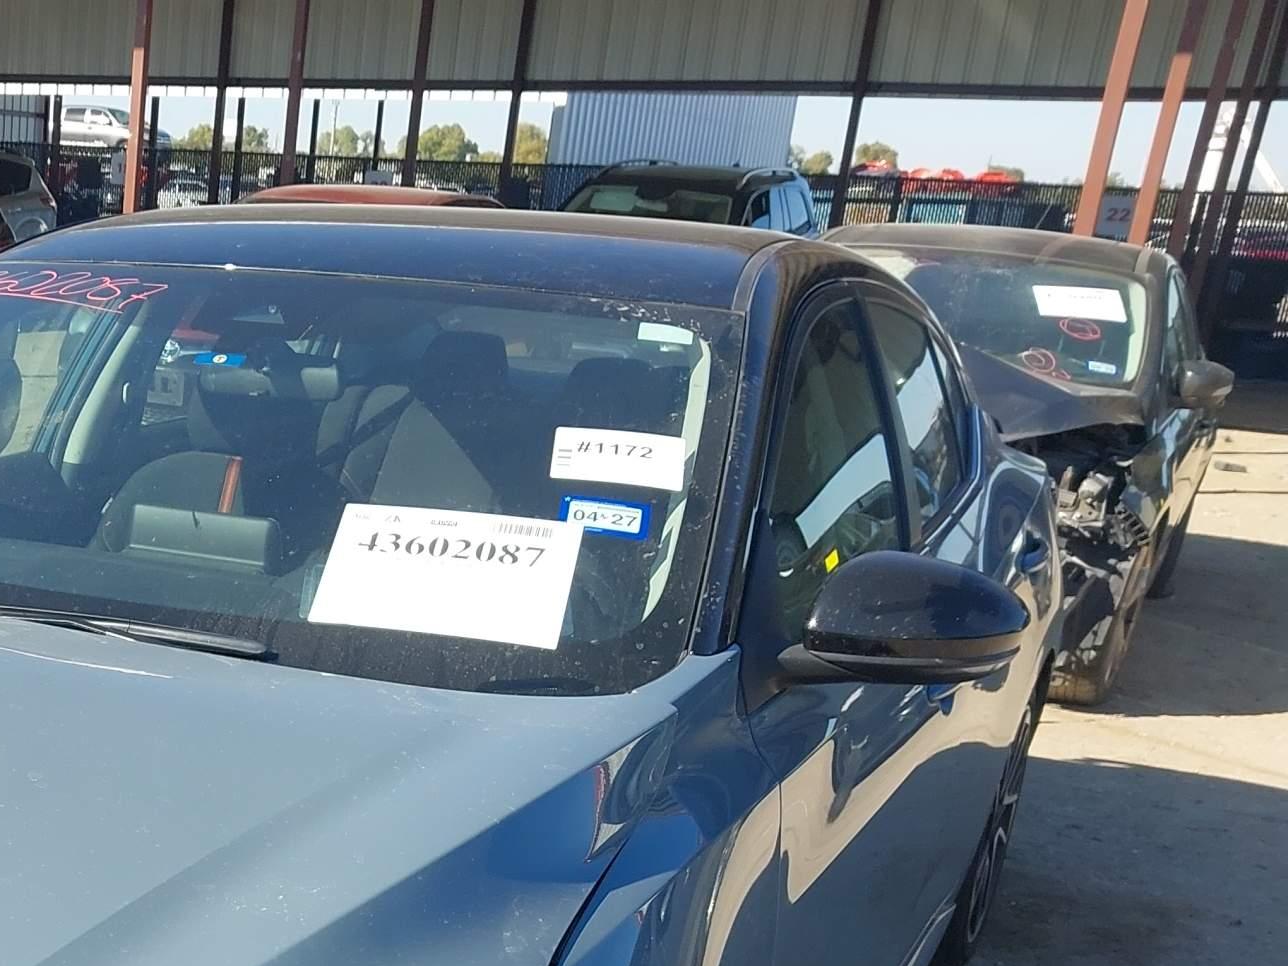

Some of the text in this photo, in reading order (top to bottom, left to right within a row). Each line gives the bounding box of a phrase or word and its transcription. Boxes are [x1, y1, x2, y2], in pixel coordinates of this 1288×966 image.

[1107, 208, 1131, 222] 22
[577, 441, 653, 459] #1172
[358, 531, 547, 567] 43602087
